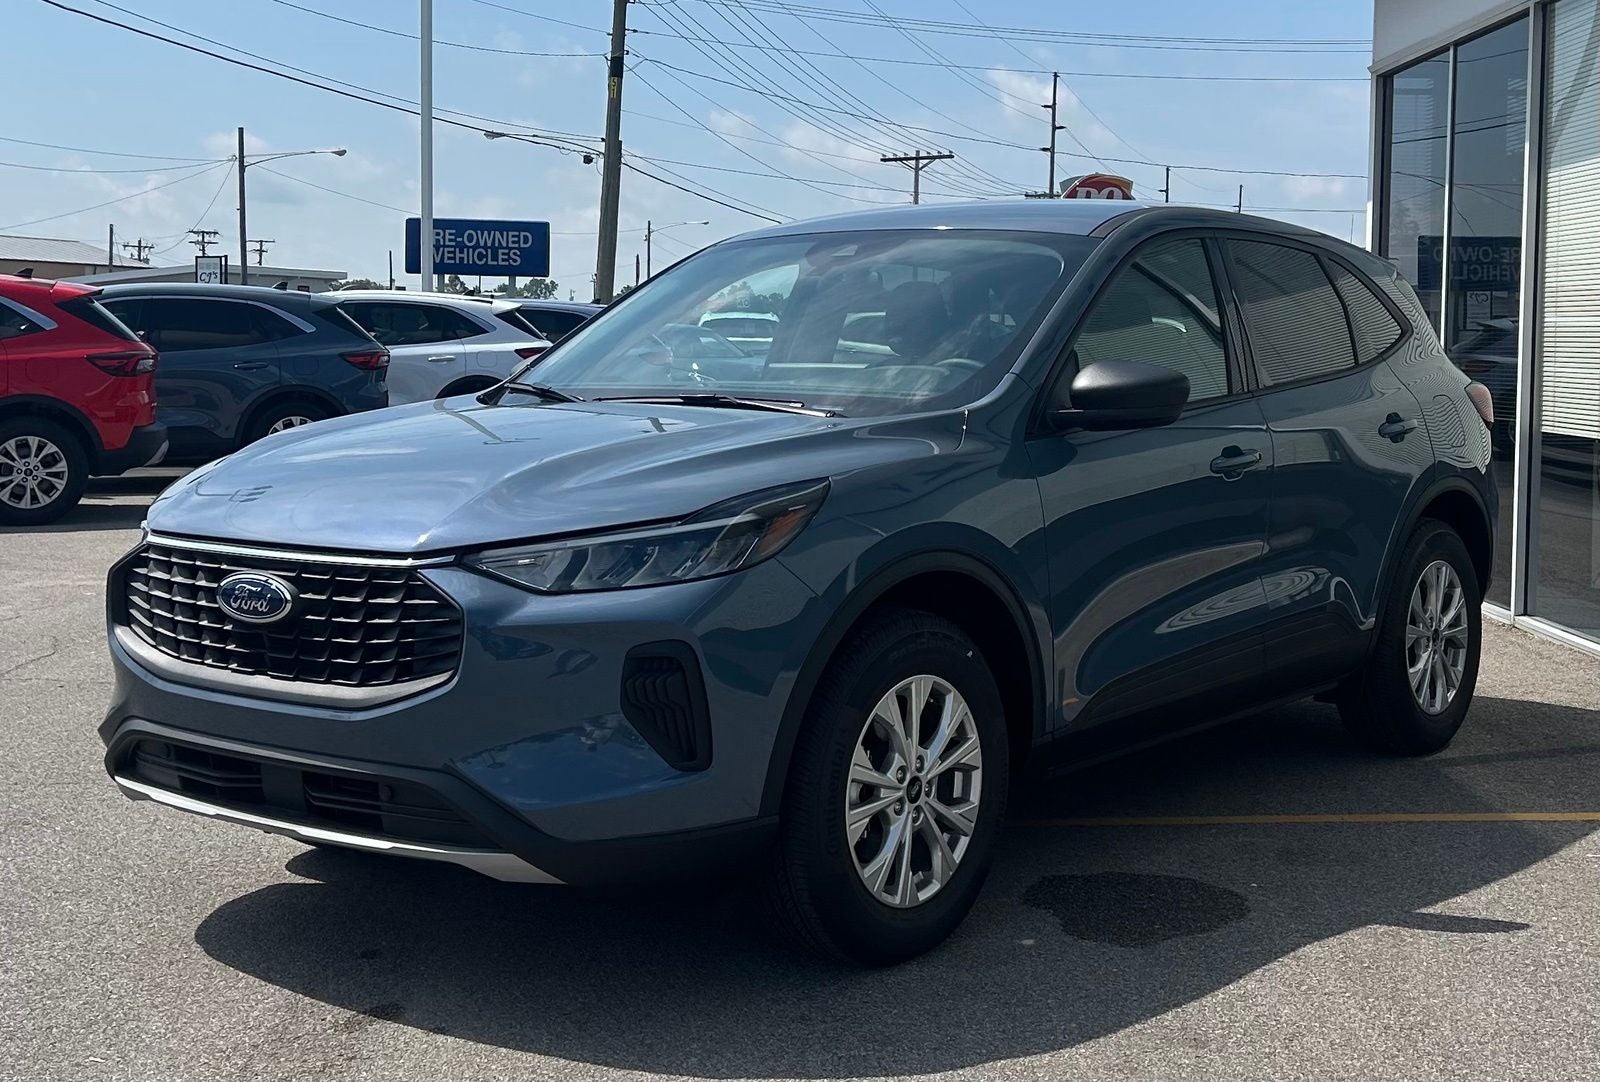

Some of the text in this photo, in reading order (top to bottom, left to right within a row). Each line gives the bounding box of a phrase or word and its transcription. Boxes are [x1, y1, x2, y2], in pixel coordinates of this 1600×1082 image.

[432, 229, 533, 248] RE-OWNED
[432, 247, 521, 265] VEHICLES
[230, 583, 271, 612] Ford
